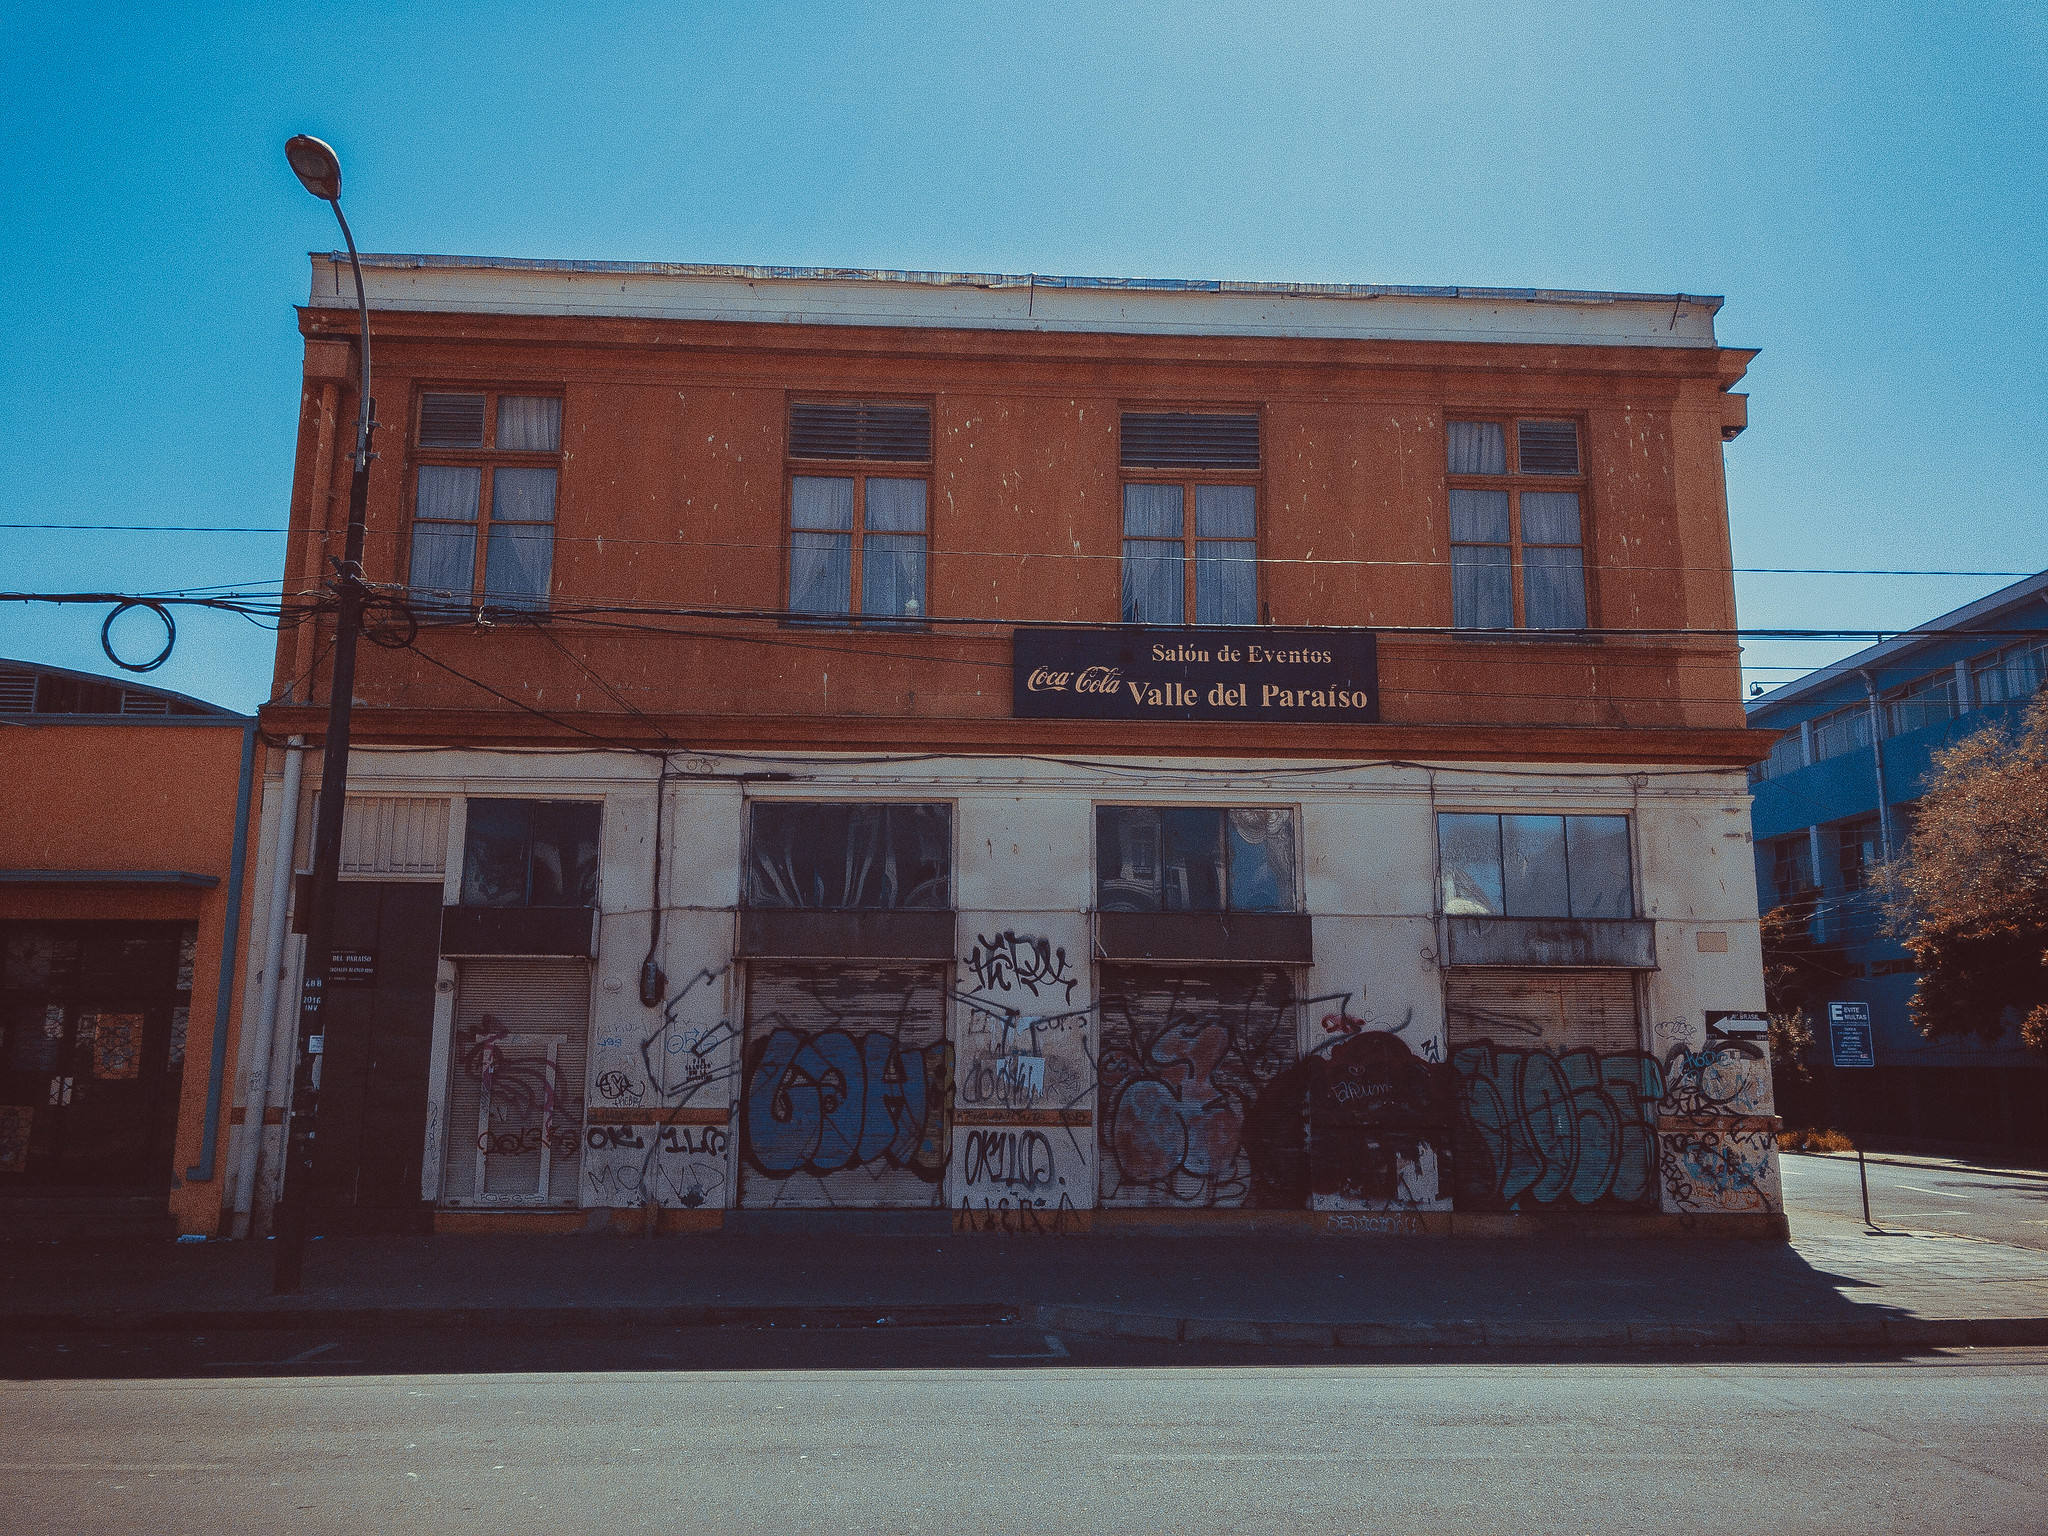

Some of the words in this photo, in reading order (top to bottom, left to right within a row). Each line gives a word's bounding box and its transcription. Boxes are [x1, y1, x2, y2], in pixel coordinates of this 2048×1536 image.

[1217, 645, 1241, 662] de
[1248, 645, 1332, 664] Eventos
[1127, 681, 1198, 706] Valle
[1208, 682, 1248, 706] del
[1260, 684, 1368, 709] Paraíso
[1831, 1004, 1844, 1021] E
